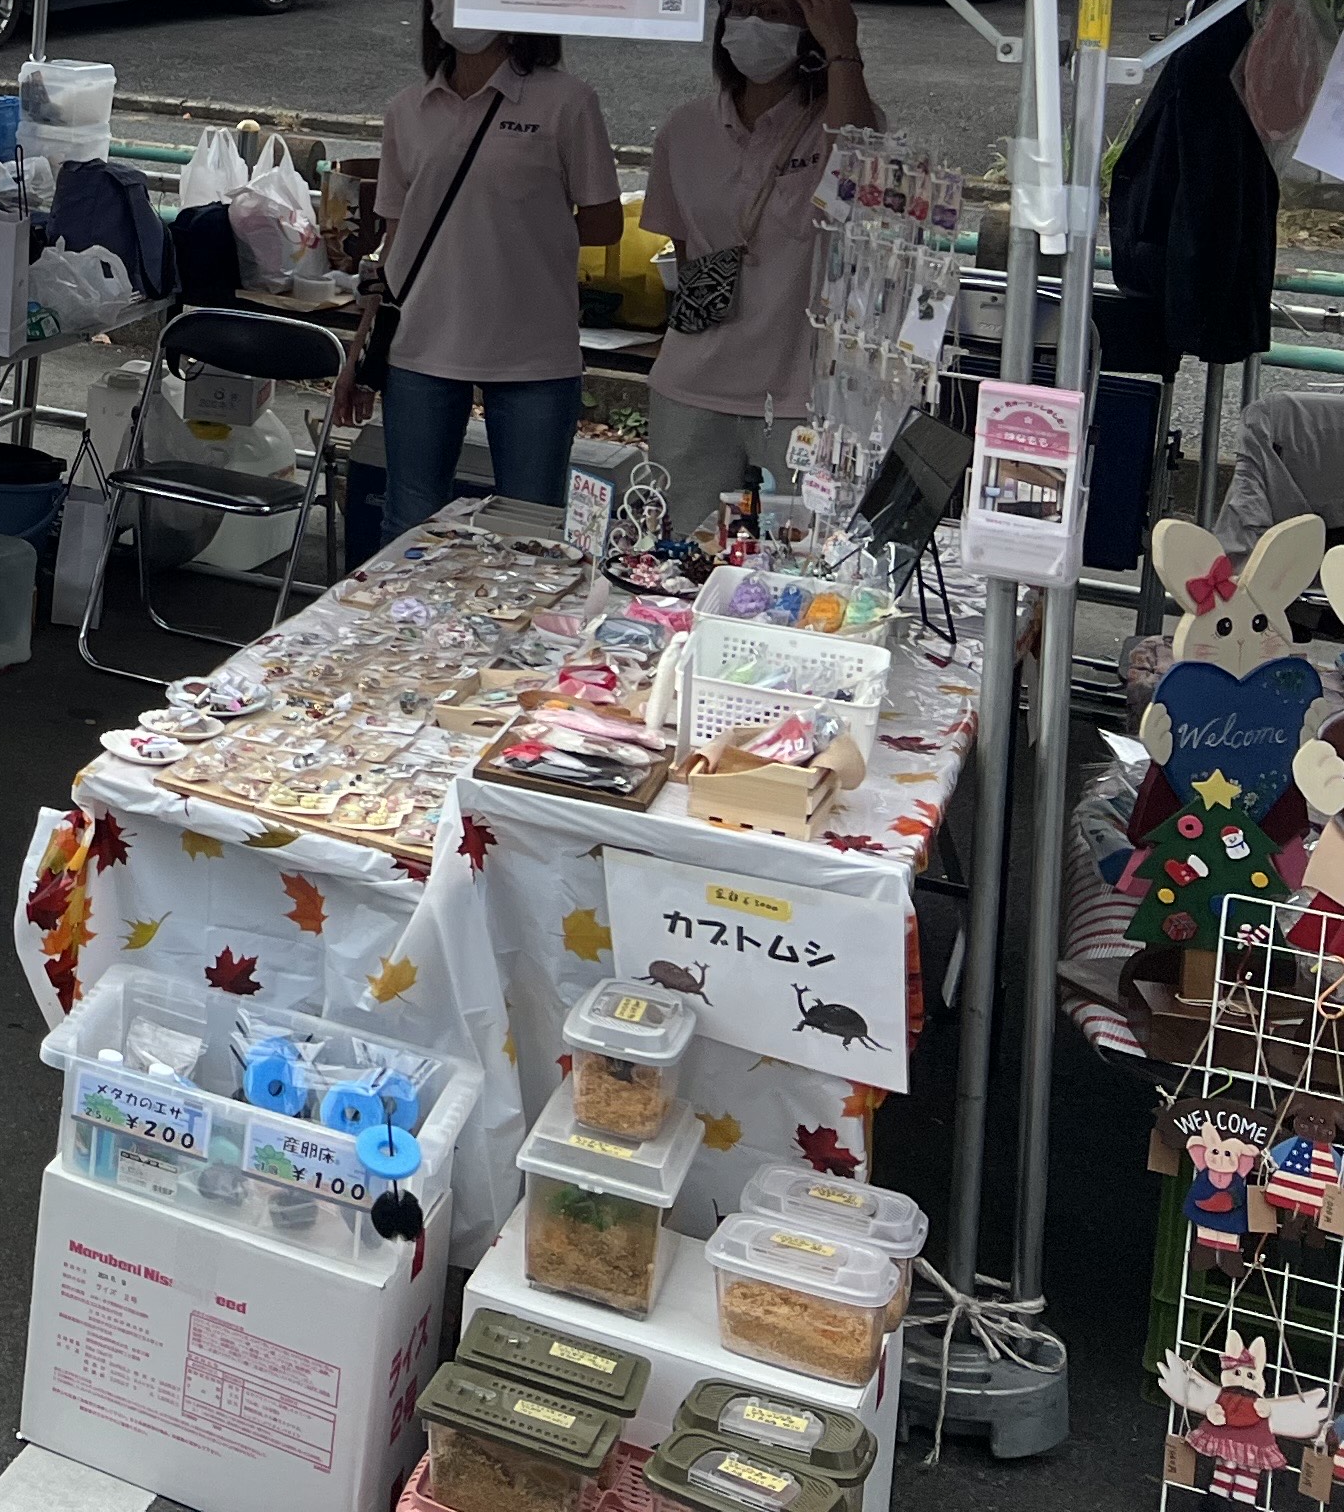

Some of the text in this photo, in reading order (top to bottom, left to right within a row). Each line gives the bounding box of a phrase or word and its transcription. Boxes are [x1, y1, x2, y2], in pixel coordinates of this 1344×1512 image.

[500, 121, 540, 133] STAFF
[573, 474, 608, 502] SALE
[1178, 712, 1289, 749] Welcome
[662, 909, 836, 968] カブトムシ
[125, 1114, 196, 1150] ¥200
[1173, 1109, 1269, 1145] WELCOME
[282, 1135, 339, 1165] 産卵床
[292, 1163, 366, 1202] ¥100
[69, 1239, 142, 1278] Marubeni
[214, 1293, 248, 1315] eed
